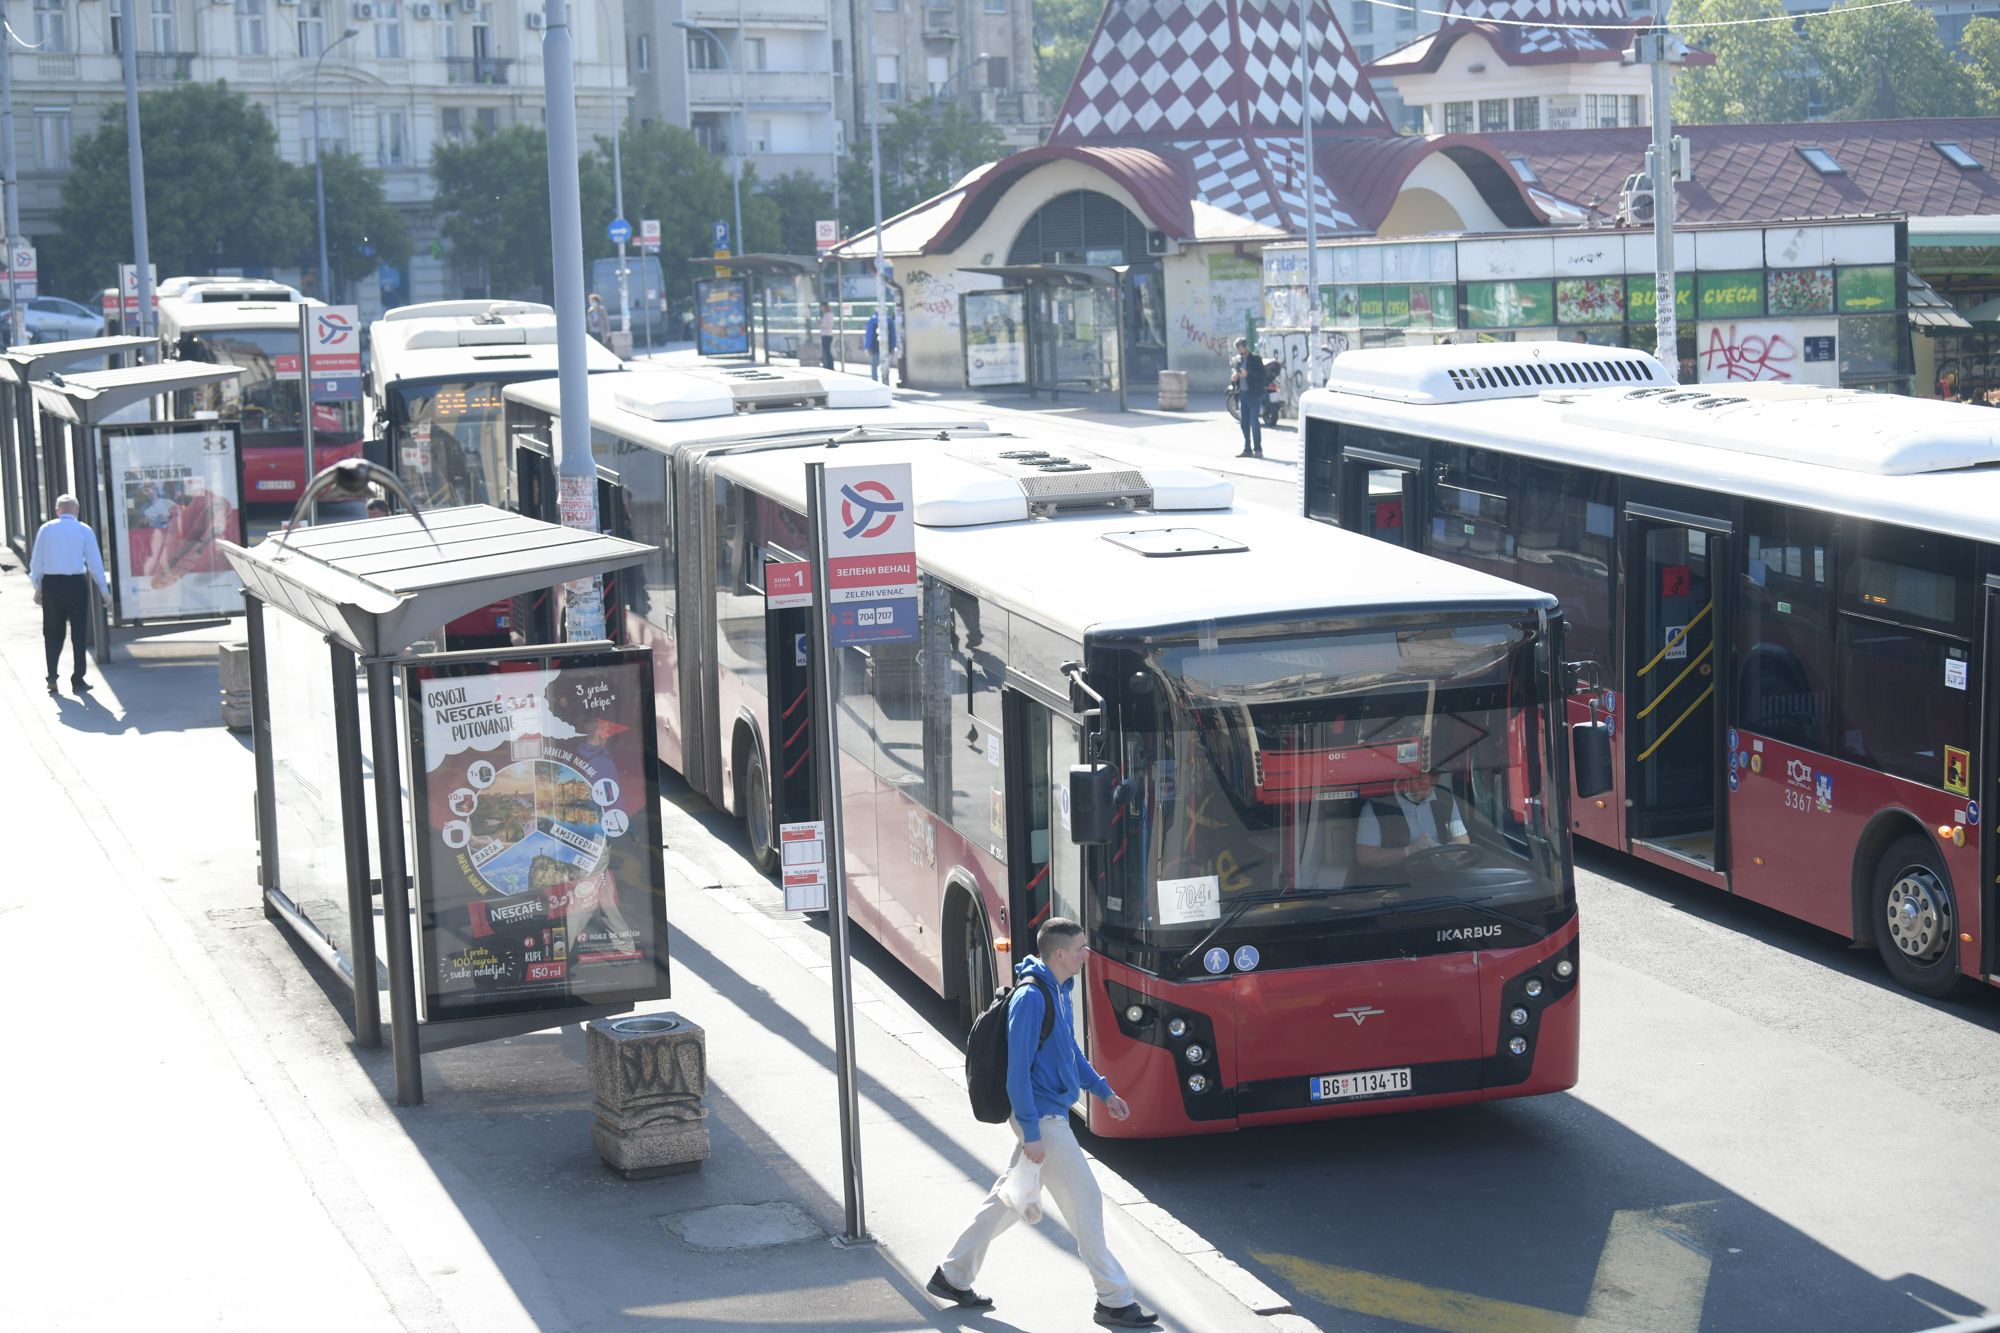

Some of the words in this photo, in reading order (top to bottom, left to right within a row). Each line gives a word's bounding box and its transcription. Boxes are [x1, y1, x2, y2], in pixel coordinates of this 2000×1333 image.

[716, 225, 726, 240] P
[1631, 289, 1690, 306] BUK
[836, 566, 876, 577] ЗЕЛЕНИ
[878, 564, 911, 575] ВЕНАЦ
[794, 570, 804, 587] 1
[845, 590, 875, 599] ZELENI
[877, 588, 904, 597] VENAC
[858, 612, 874, 621] 704
[876, 611, 892, 620] 707
[428, 687, 467, 708] OSVOJI
[576, 685, 584, 696] 3
[587, 681, 609, 699] grada
[583, 698, 589, 709] 1
[452, 715, 516, 741] PUTOVANJE
[1785, 788, 1812, 813] 3367
[555, 826, 599, 854] AMSTERDAM
[474, 844, 499, 862] BARSA
[576, 857, 591, 869] RIO
[1176, 884, 1206, 909] 704
[506, 914, 534, 923] CLASSIC
[1437, 925, 1502, 941] IKARBUS
[454, 957, 470, 967] 100
[525, 950, 542, 962] KUPI
[450, 967, 471, 979] svake
[531, 967, 549, 978] 150
[1323, 1080, 1340, 1096] BG
